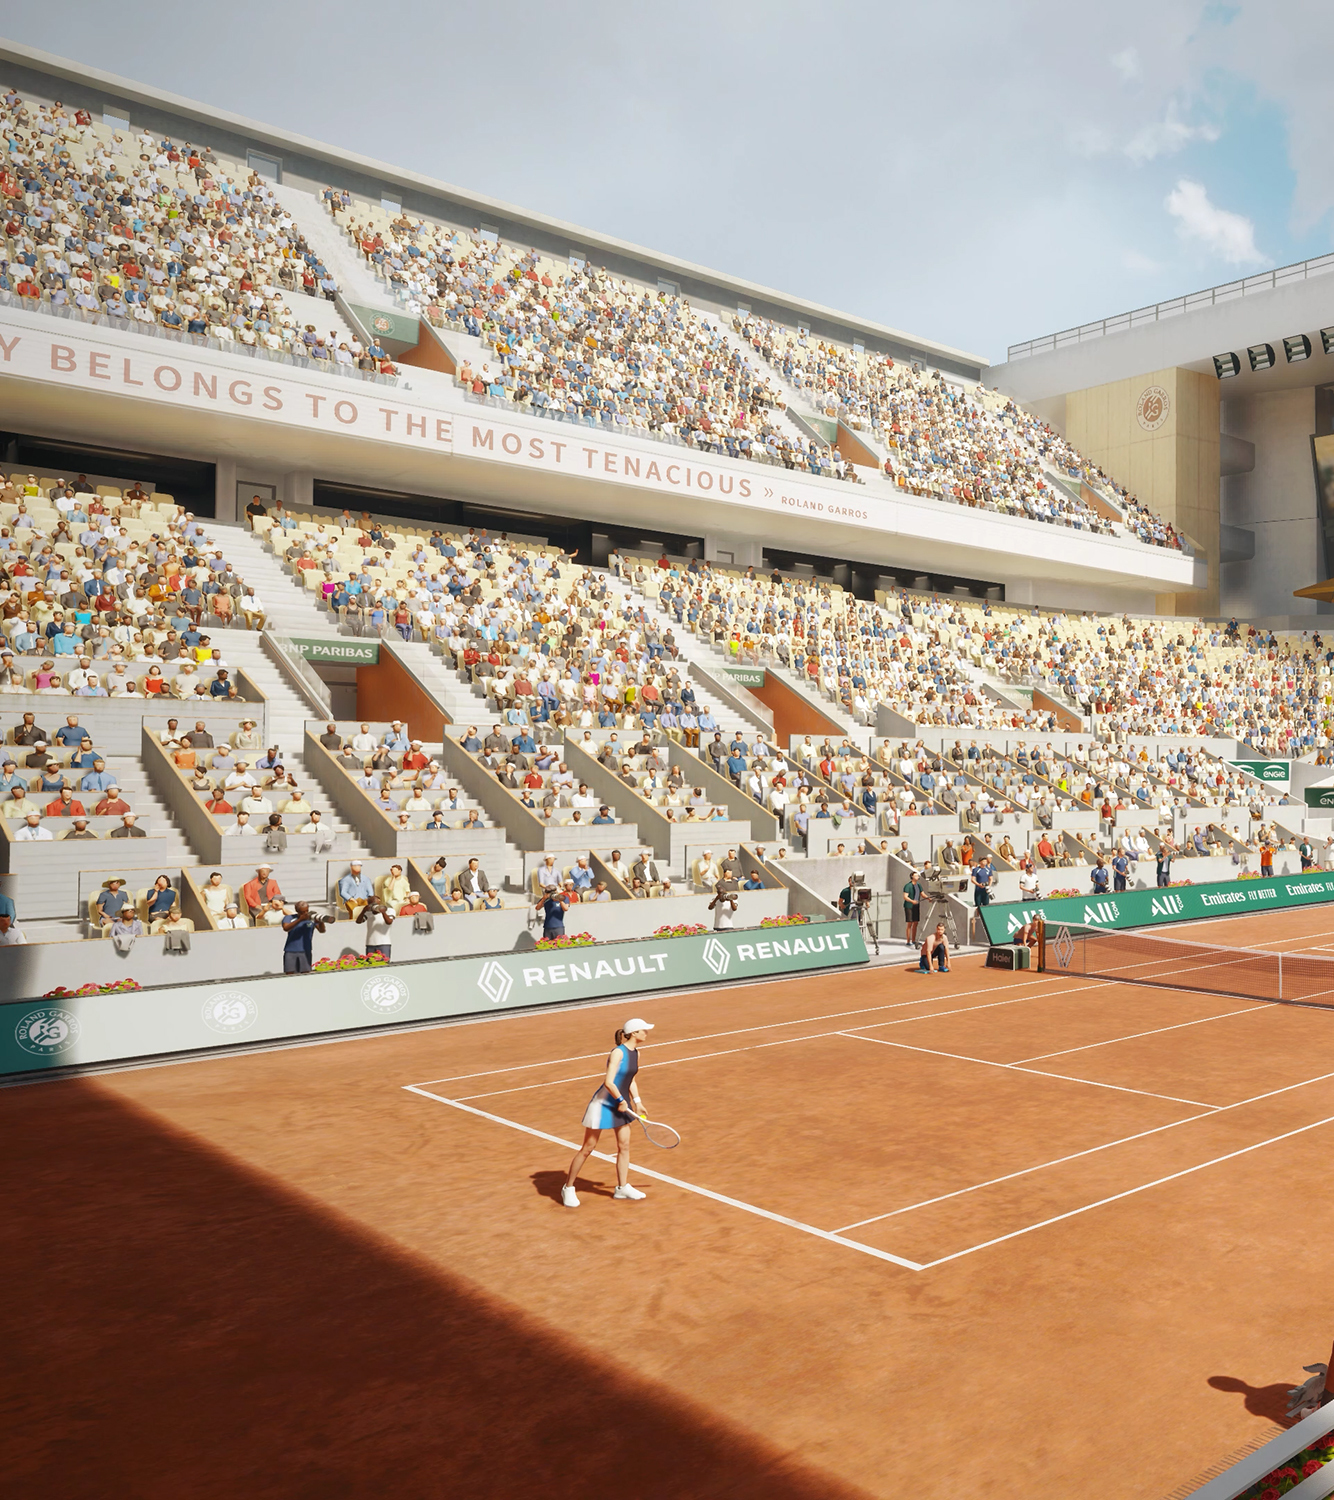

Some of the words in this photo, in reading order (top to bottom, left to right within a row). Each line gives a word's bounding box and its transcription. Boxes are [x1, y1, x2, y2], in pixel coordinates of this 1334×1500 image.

[50, 343, 285, 411] BELONGS
[305, 393, 359, 425] TO
[379, 407, 453, 443] THE
[472, 425, 567, 463] MOST
[582, 447, 752, 498] TENACIOUS
[781, 495, 824, 512] ROLAND
[827, 505, 868, 520] GARROS
[312, 645, 373, 659] PARIBAS
[722, 673, 761, 683] PARIBAS
[1200, 890, 1246, 906] Emirates
[1247, 890, 1258, 900] FLY
[1285, 882, 1325, 897] Emirates
[1083, 902, 1116, 925] All
[1151, 895, 1181, 917] All
[738, 932, 851, 962] RENAULT
[992, 952, 1011, 964] Haier
[522, 952, 669, 988] RENAULT
[18, 1011, 46, 1040] ROLAND
[49, 1010, 79, 1034] GARROS
